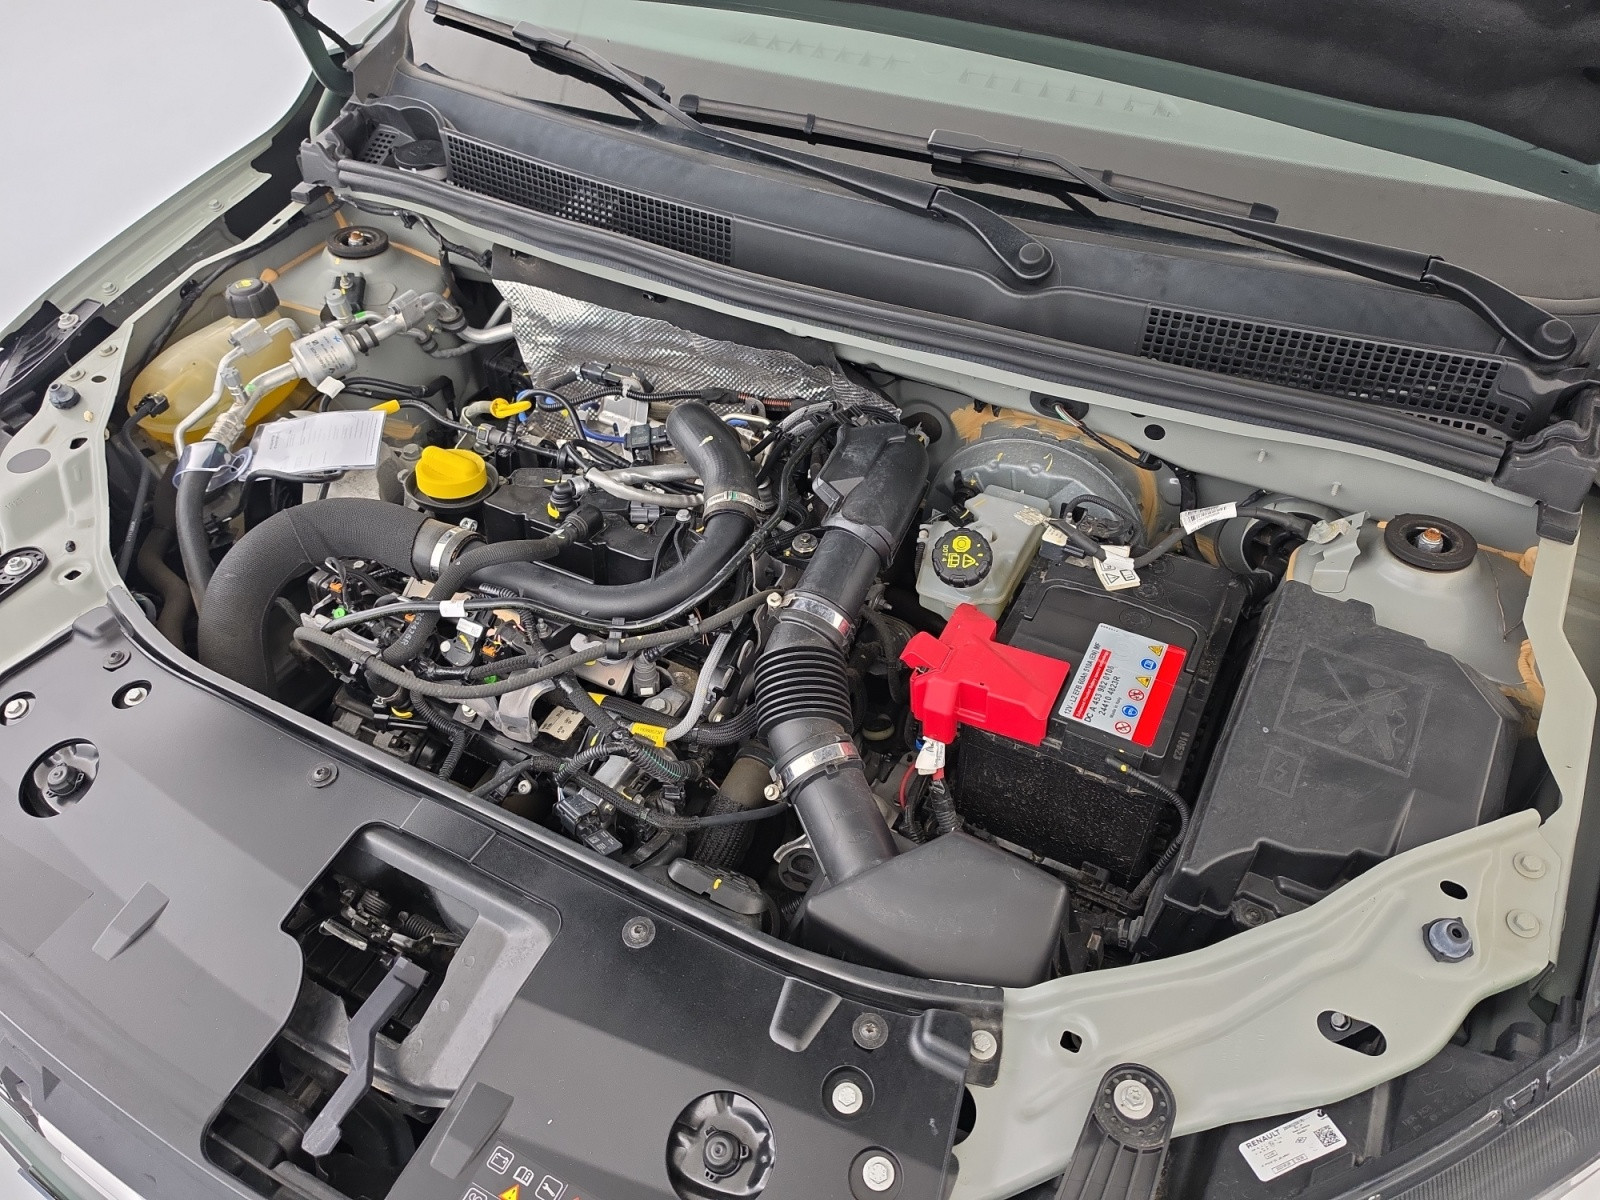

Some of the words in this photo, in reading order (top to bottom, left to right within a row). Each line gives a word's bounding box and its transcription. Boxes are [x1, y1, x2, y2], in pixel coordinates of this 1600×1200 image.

[1078, 673, 1088, 685] 60Ah
[1073, 684, 1083, 696] EFB
[1098, 695, 1112, 716] 24410
[1107, 675, 1121, 696] 4823R
[1070, 695, 1078, 704] L2
[1084, 712, 1094, 723] DC
[1092, 693, 1103, 706] 453
[1098, 681, 1108, 693] 982
[1064, 704, 1073, 715] 12V
[1245, 1129, 1281, 1149] RENAULT
